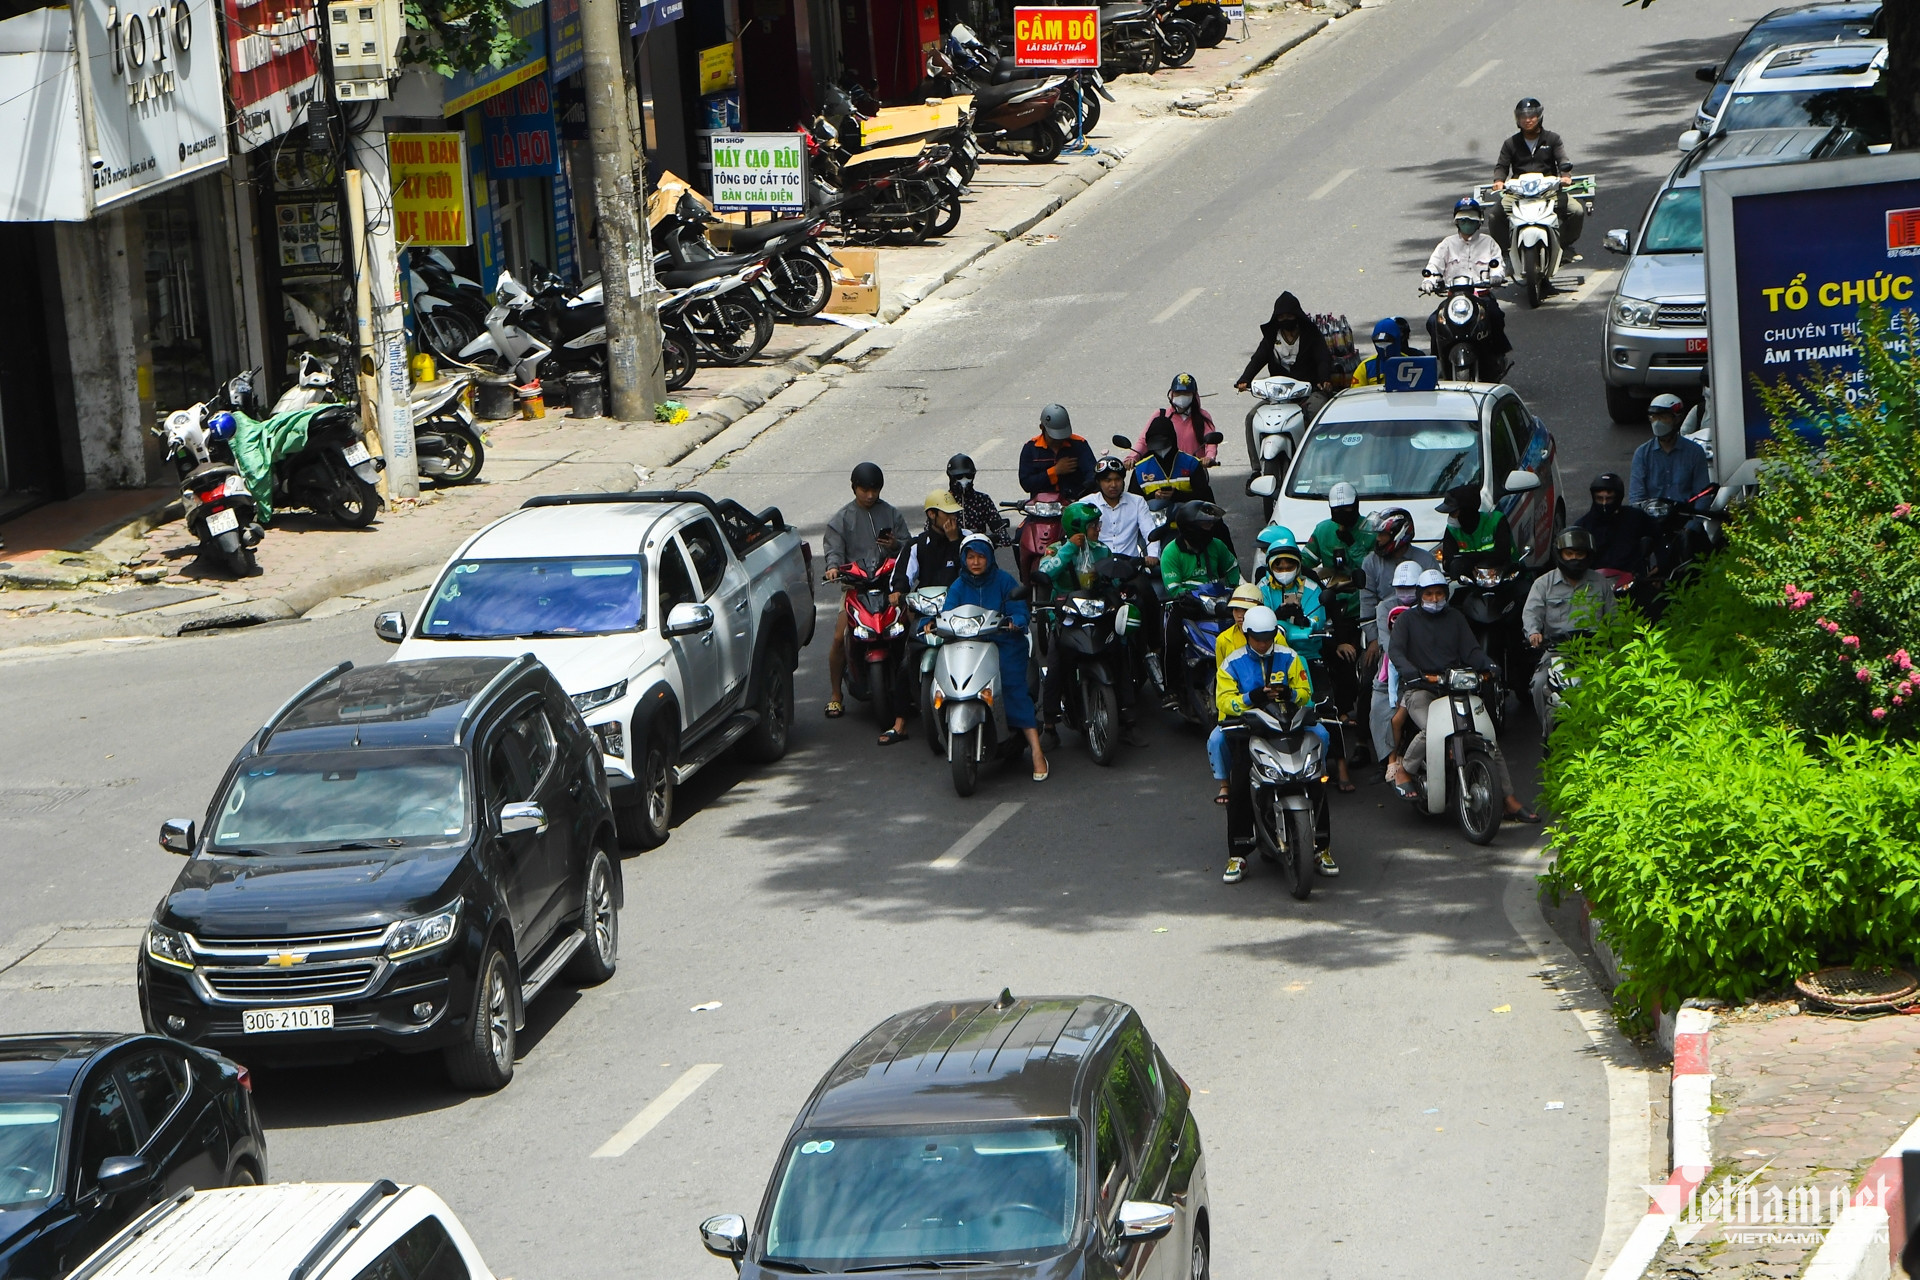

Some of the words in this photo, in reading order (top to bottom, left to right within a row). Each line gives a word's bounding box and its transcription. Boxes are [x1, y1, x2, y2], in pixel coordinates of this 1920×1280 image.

[1017, 13, 1062, 41] CẦM
[1068, 13, 1095, 41] ĐỒ
[1041, 41, 1063, 51] SUẤT
[1064, 41, 1087, 51] THẤP
[391, 141, 425, 164] MUA
[428, 137, 459, 164] BÁN
[517, 130, 551, 166] HƠI
[714, 146, 741, 168] MÁY
[773, 146, 799, 168] RÂU
[100, 166, 112, 187] 678
[714, 171, 740, 185] TÔNG
[743, 174, 757, 185] ĐƠ
[760, 169, 778, 185] CẮT
[781, 172, 800, 185] TÓC
[722, 188, 742, 201] BÀN
[771, 188, 793, 204] ĐIỆN
[397, 211, 420, 241] XE
[424, 206, 462, 241] MÁY
[1762, 272, 1809, 312] TỔ
[1818, 270, 1914, 307] CHỨC
[1764, 322, 1826, 342] CHUYÊN
[1763, 348, 1791, 364] ÂM
[1794, 344, 1854, 362] THANH
[1396, 361, 1424, 388] G7
[1141, 471, 1156, 482] be
[245, 1009, 330, 1031] 30G-210.18
